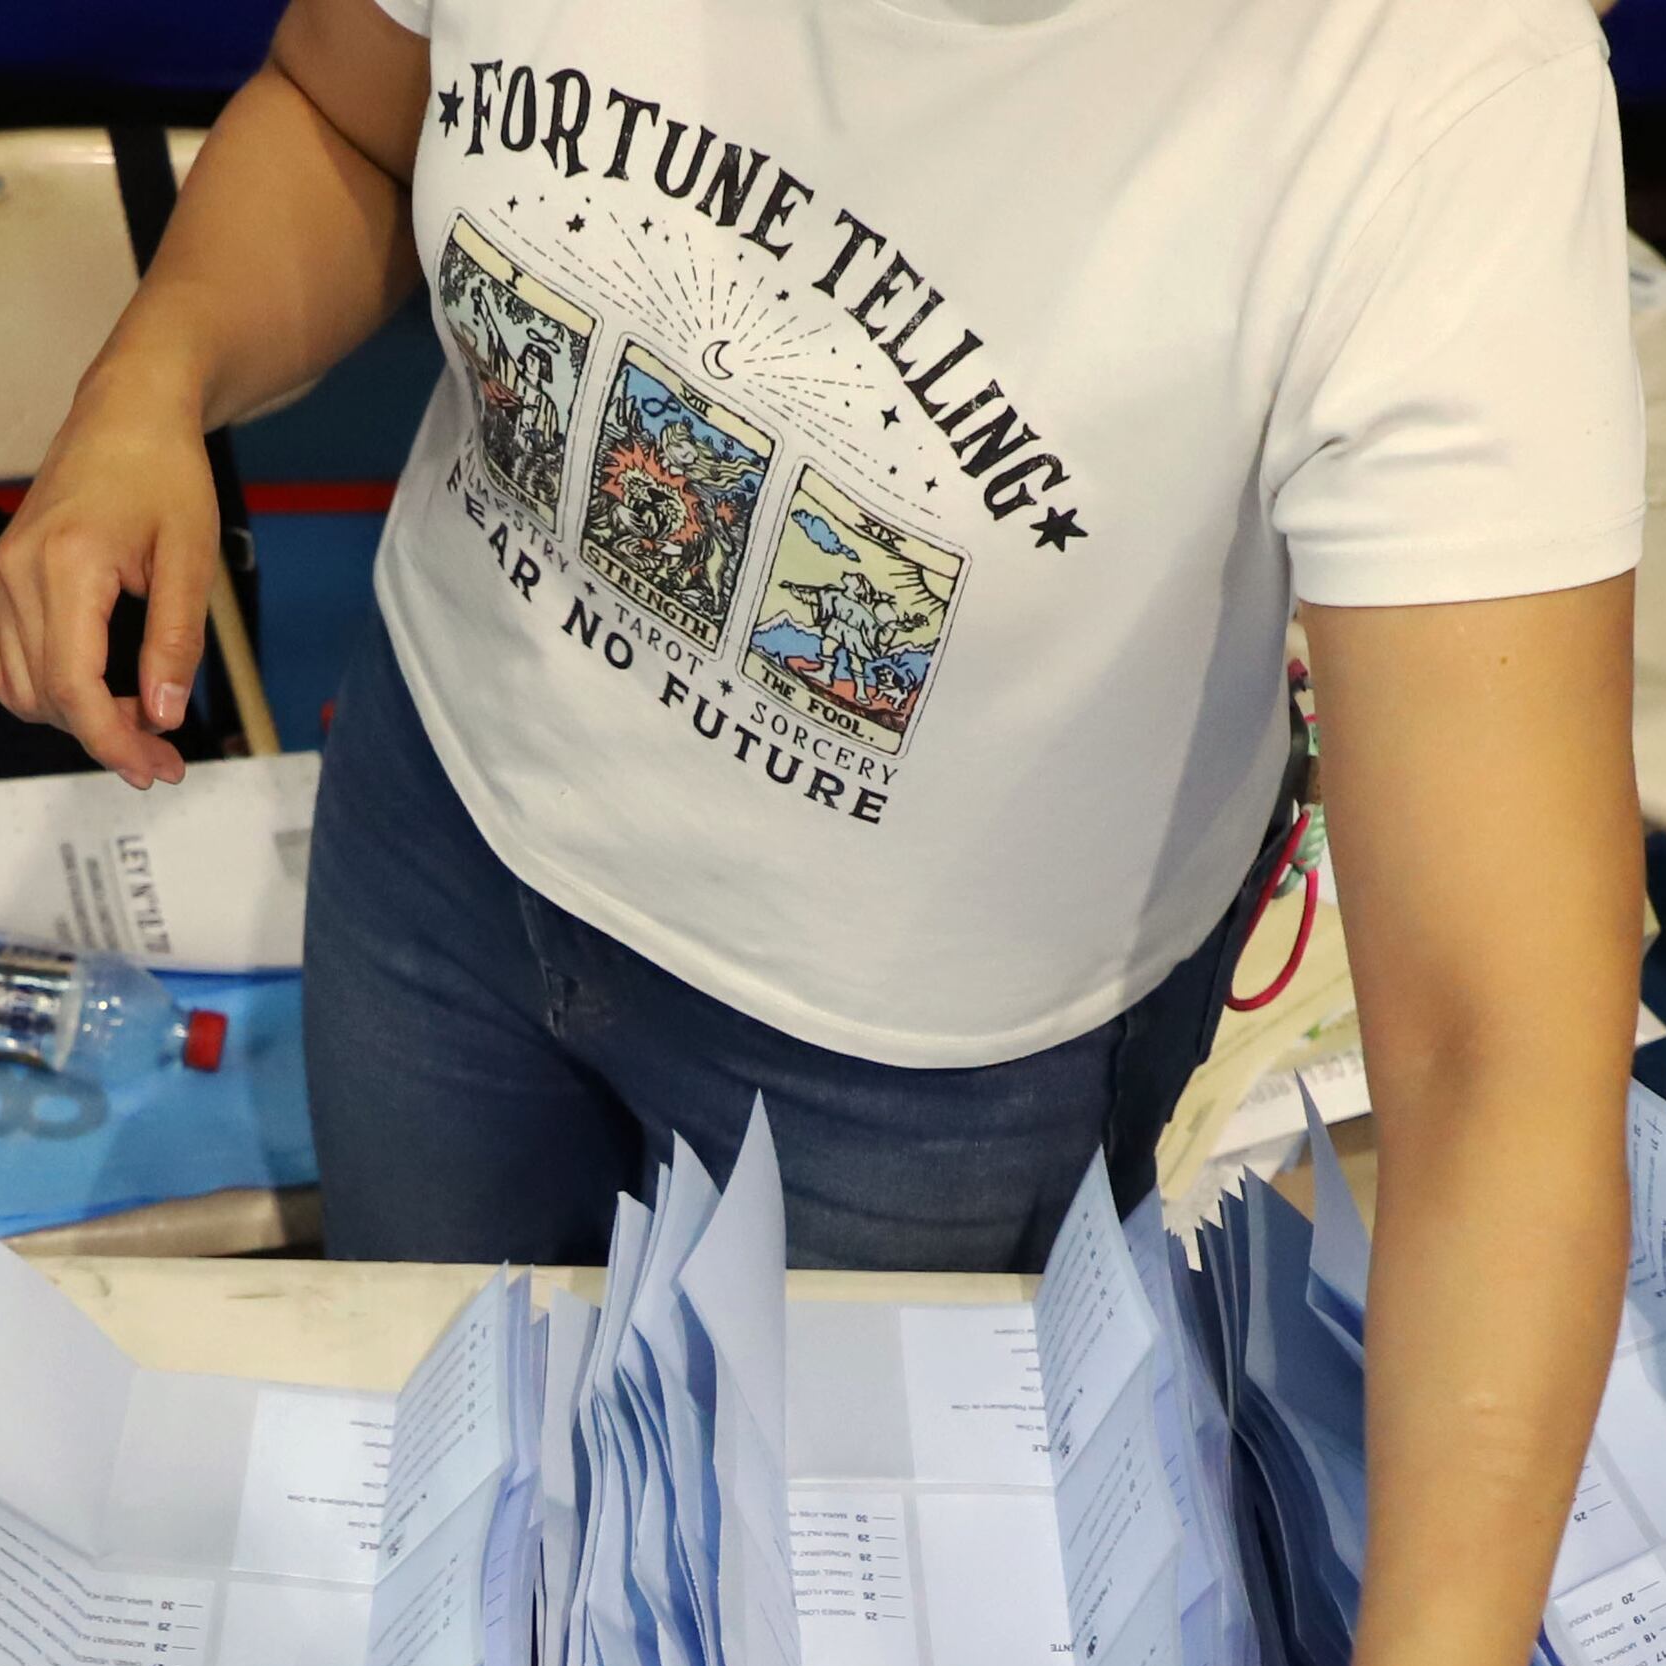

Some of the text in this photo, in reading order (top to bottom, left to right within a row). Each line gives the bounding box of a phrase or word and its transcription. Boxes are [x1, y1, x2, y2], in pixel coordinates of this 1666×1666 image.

[464, 60, 1071, 520] FORTUNE TELLING
[585, 545, 715, 646] STRENGTH.
[447, 458, 889, 825] FEAR NO FUTURE
[614, 601, 704, 676] TAROT
[749, 701, 899, 787] SORCERY
[761, 664, 874, 742] THE FOOL.
[1621, 1592, 1635, 1605] 20
[1633, 1613, 1646, 1625] 19
[1643, 1631, 1656, 1643] 18
